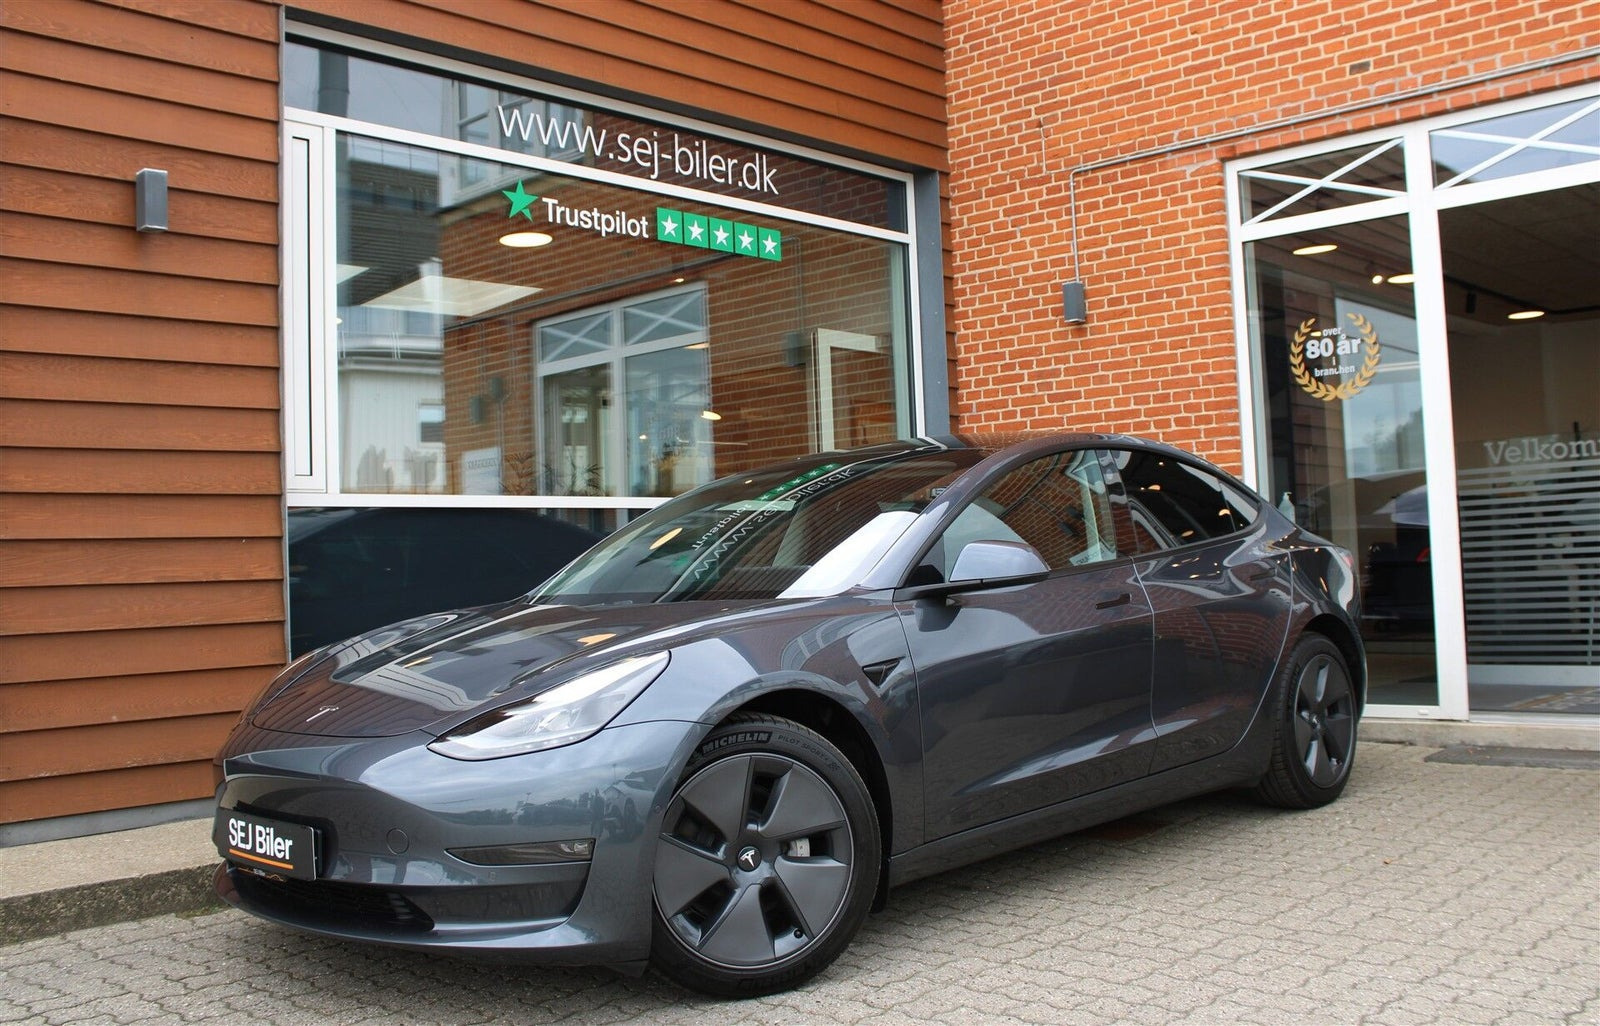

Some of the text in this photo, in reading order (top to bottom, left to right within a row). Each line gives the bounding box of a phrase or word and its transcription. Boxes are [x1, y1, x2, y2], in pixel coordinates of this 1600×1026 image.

[497, 105, 779, 195] www.sej-biler.dk
[542, 197, 649, 239] Trustpilot
[1323, 328, 1341, 337] over
[1306, 334, 1361, 358] 80 år
[702, 732, 769, 754] MICHELIN
[777, 734, 800, 746] PILOT
[229, 818, 293, 860] SEJ Biler
